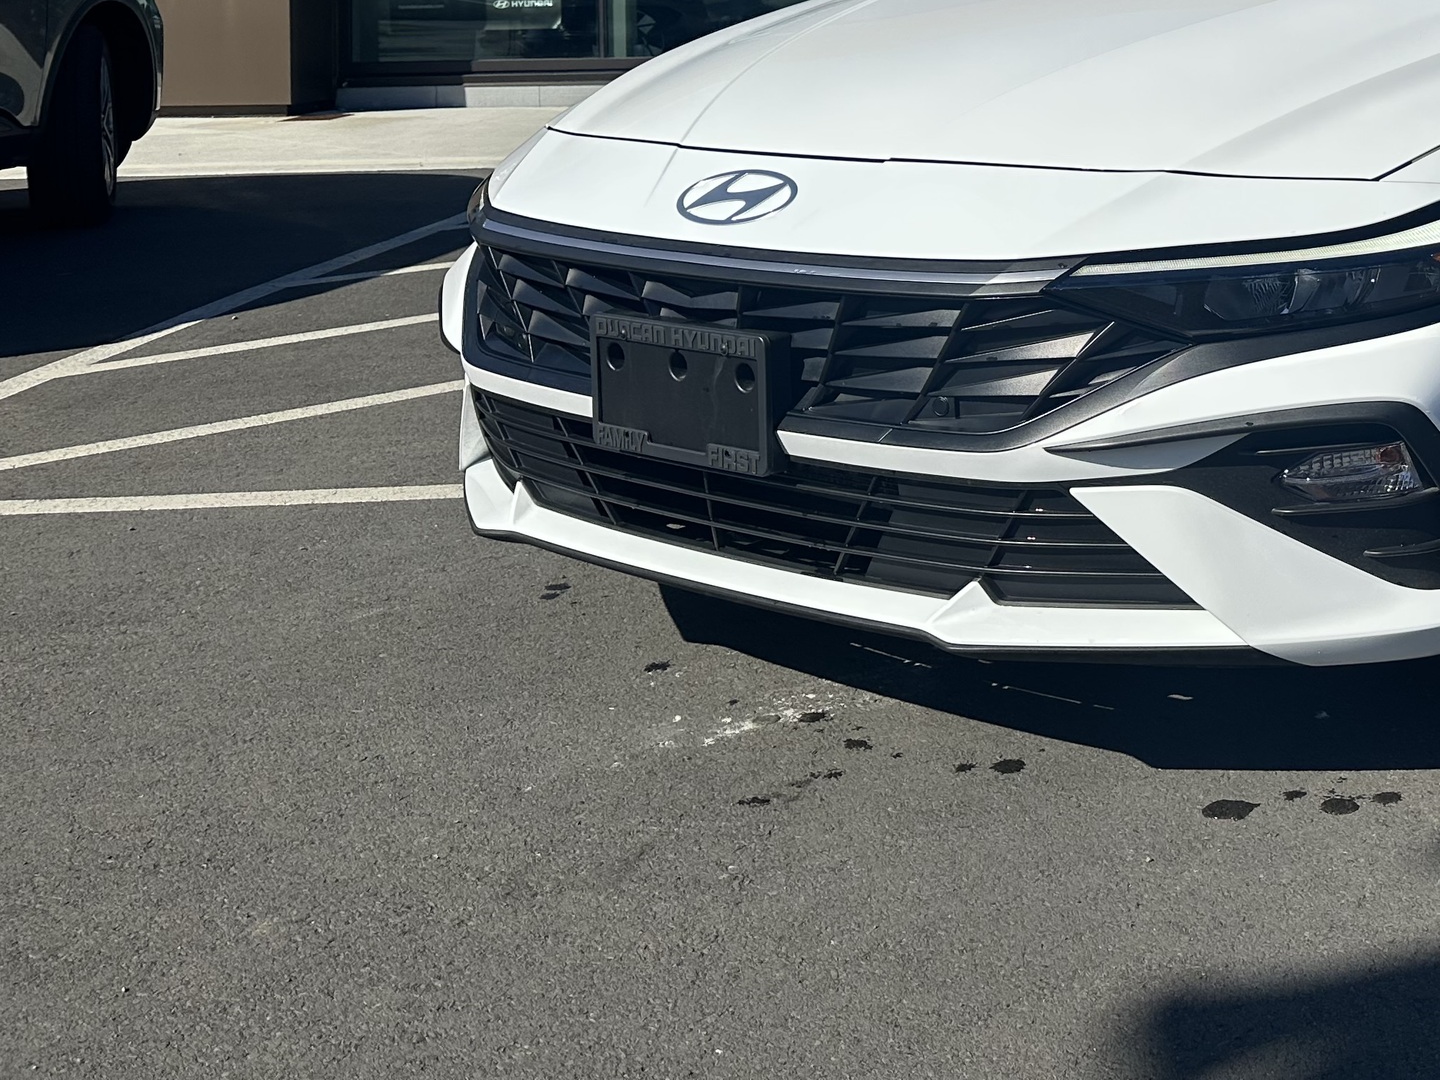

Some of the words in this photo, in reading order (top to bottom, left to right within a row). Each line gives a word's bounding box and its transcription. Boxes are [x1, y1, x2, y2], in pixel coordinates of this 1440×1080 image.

[510, 0, 554, 8] HYUNDAI
[596, 318, 666, 344] DUNCAN
[670, 328, 757, 357] HYUNDAI
[596, 424, 647, 453] FAMILY
[708, 446, 761, 475] FIRST
